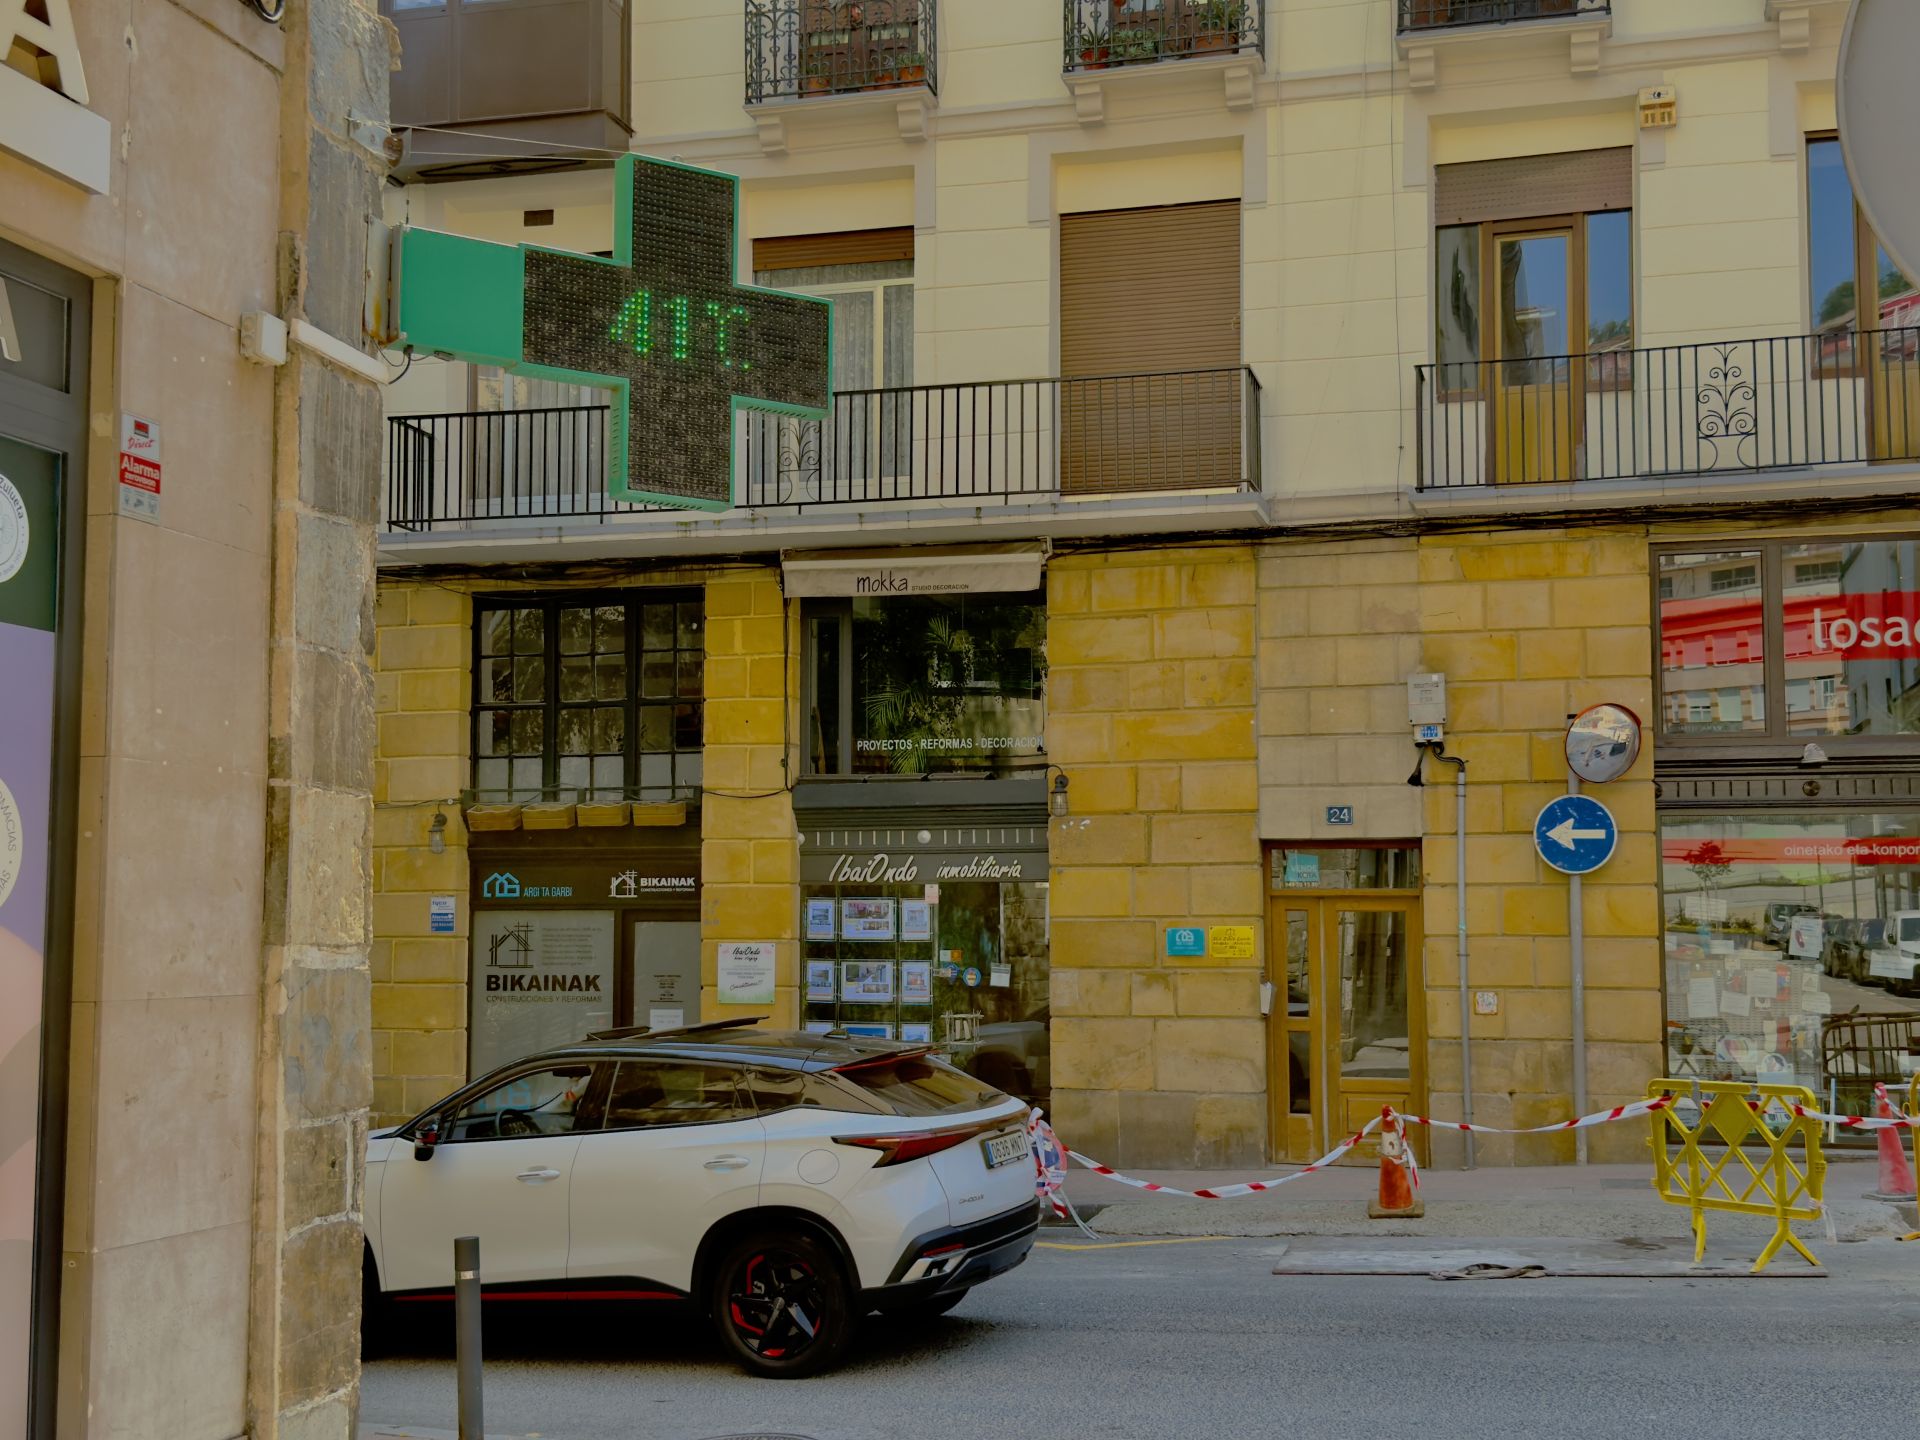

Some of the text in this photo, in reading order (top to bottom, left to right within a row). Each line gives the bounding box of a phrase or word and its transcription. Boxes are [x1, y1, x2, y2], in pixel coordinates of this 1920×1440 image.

[121, 454, 161, 480] Alarma
[856, 570, 908, 592] mokka
[1813, 607, 1920, 649] losa
[856, 739, 913, 752] PROYECTOS
[920, 737, 973, 750] REFORMAS
[1330, 808, 1349, 822] 24
[1784, 844, 1843, 856] oinetako
[936, 855, 1022, 878] inmobiliaria
[640, 877, 696, 887] BIKAINAK
[486, 974, 602, 992] BIKAINAK
[486, 995, 554, 1004] CONSTRUCCIONES
[561, 994, 603, 1004] REFORMAS
